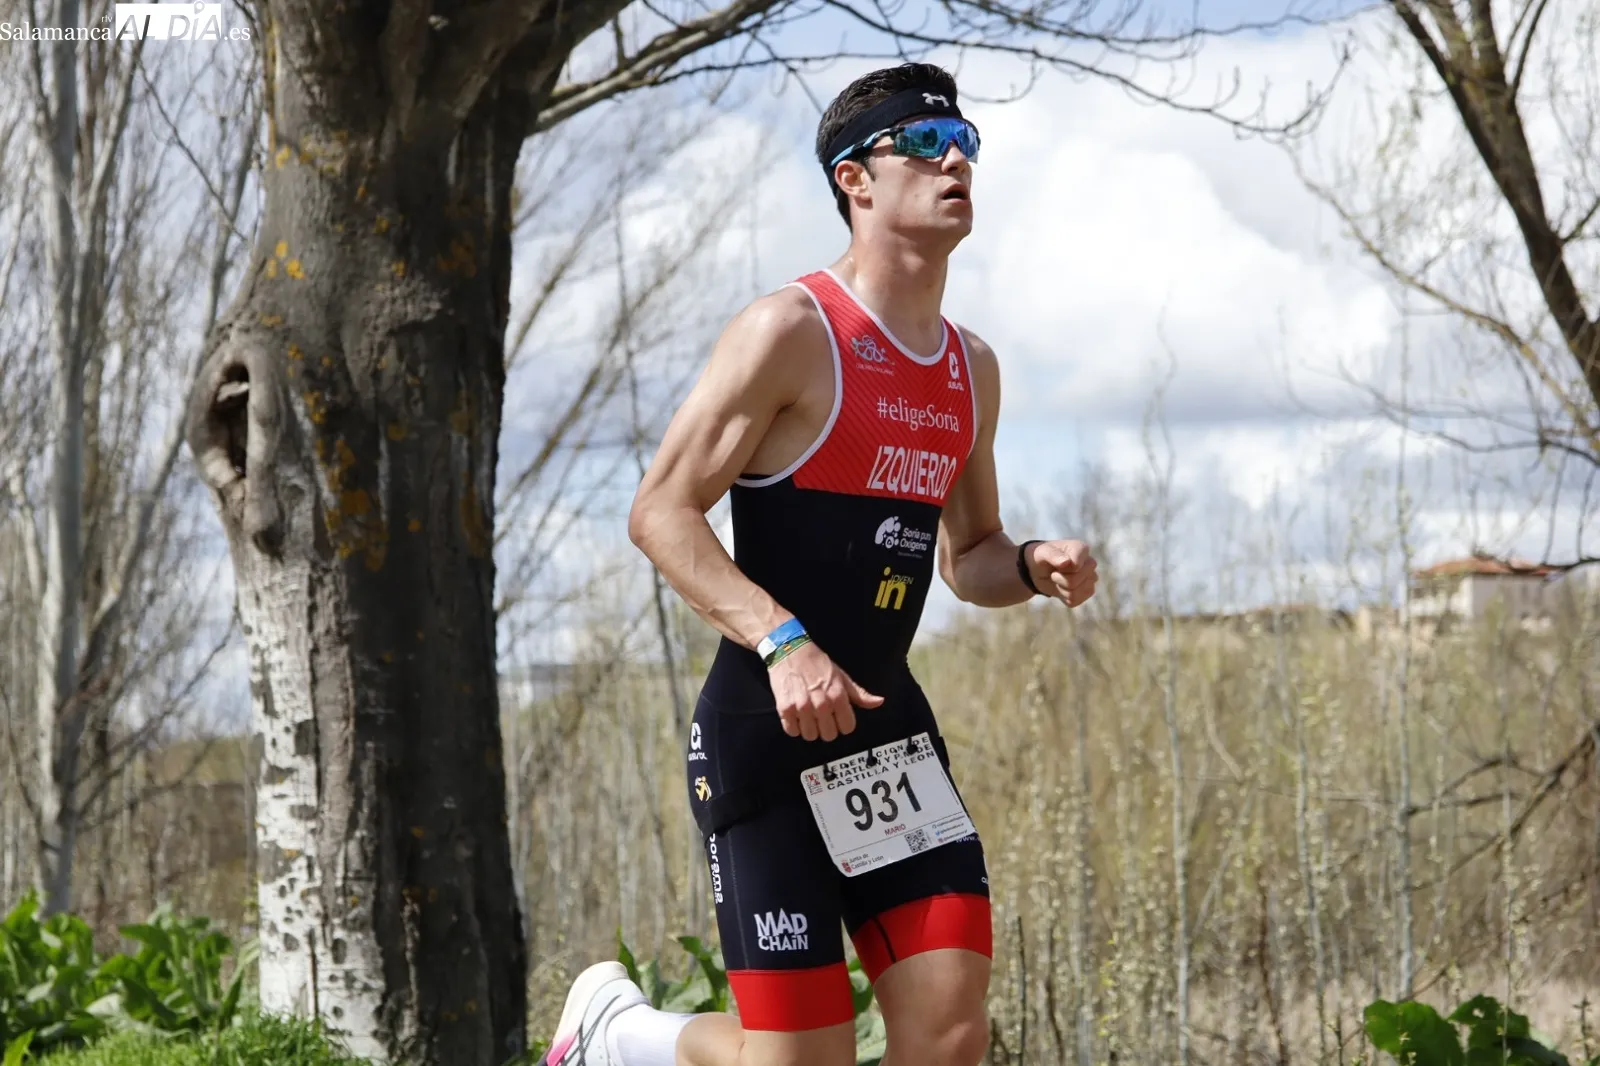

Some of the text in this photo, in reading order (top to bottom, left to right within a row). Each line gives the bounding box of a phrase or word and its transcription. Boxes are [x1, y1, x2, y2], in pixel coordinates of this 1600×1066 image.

[877, 396, 960, 433] #eligeSoria
[866, 445, 957, 500] IZQUIERDO
[902, 527, 920, 539] Soria
[874, 566, 907, 610] in
[827, 765, 889, 790] CASTILLA
[904, 750, 935, 766] LEON
[828, 744, 904, 774] EDERCION
[845, 772, 922, 831] 931
[884, 823, 906, 836] MARIO
[851, 860, 868, 869] Castilla
[754, 908, 808, 937] MAD
